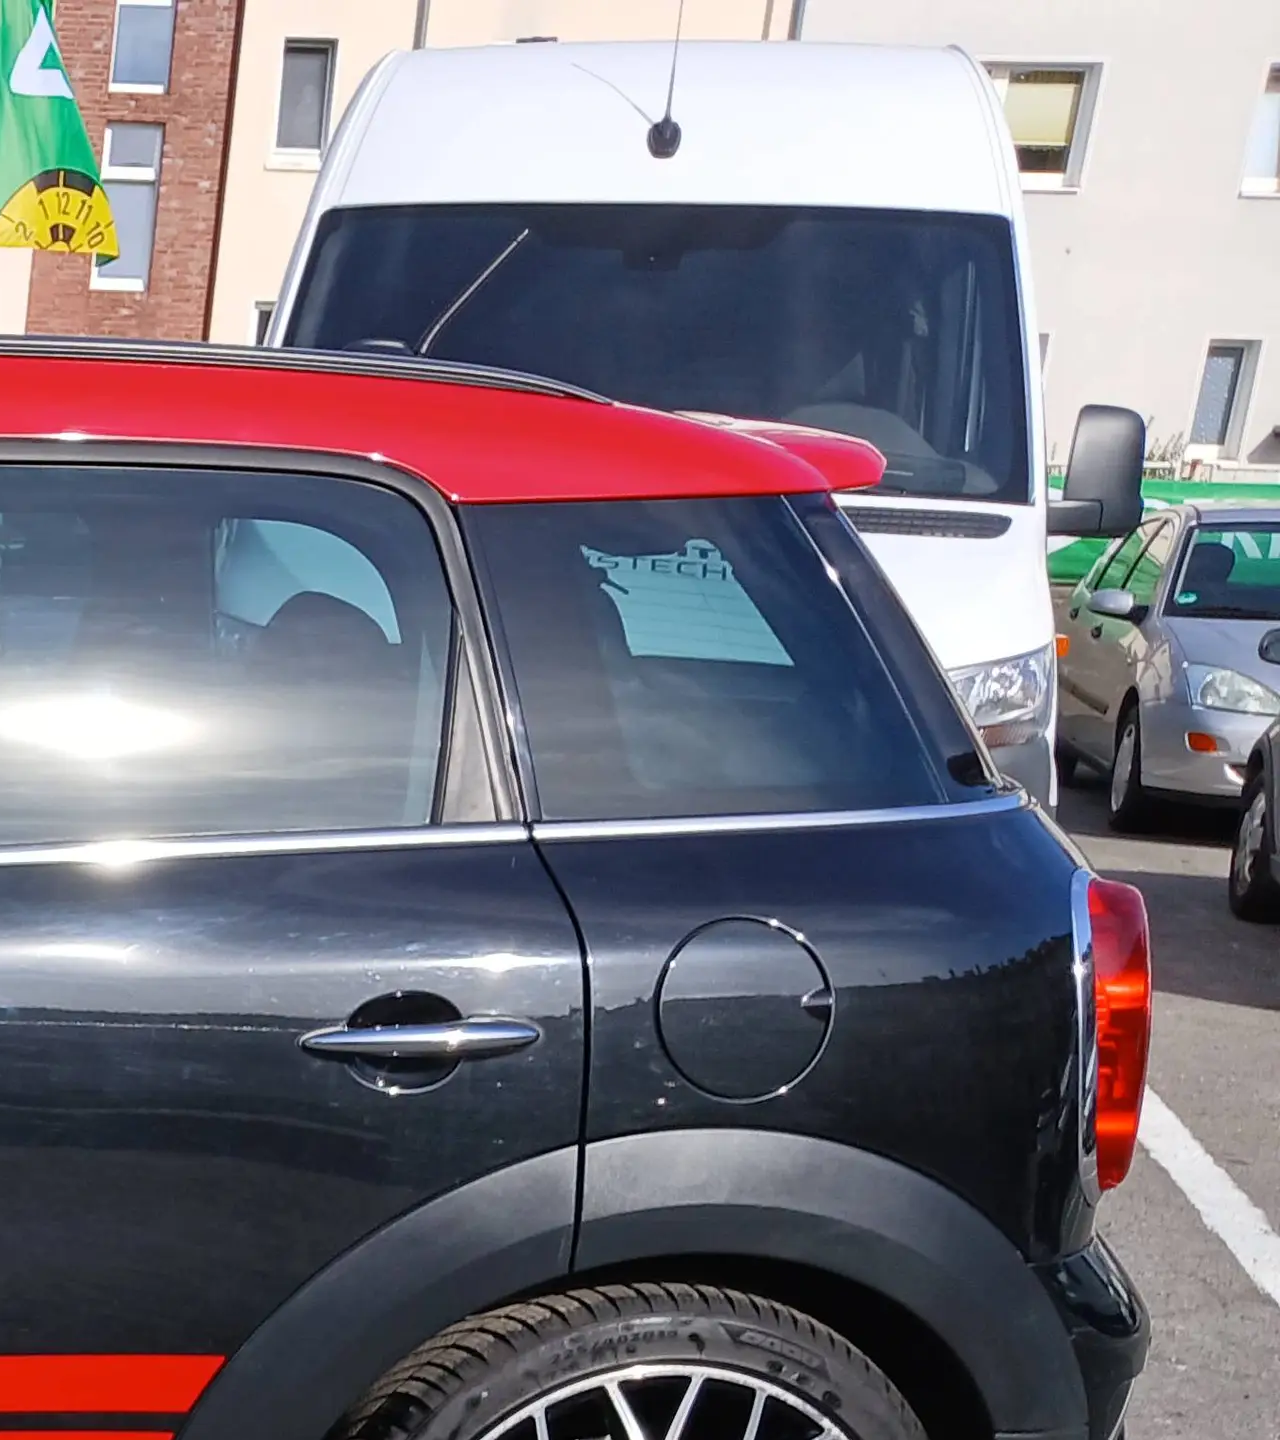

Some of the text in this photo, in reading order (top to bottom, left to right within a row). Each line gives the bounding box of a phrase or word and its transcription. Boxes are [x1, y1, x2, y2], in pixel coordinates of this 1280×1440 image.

[15, 191, 105, 249] 2 1 12 11 10
